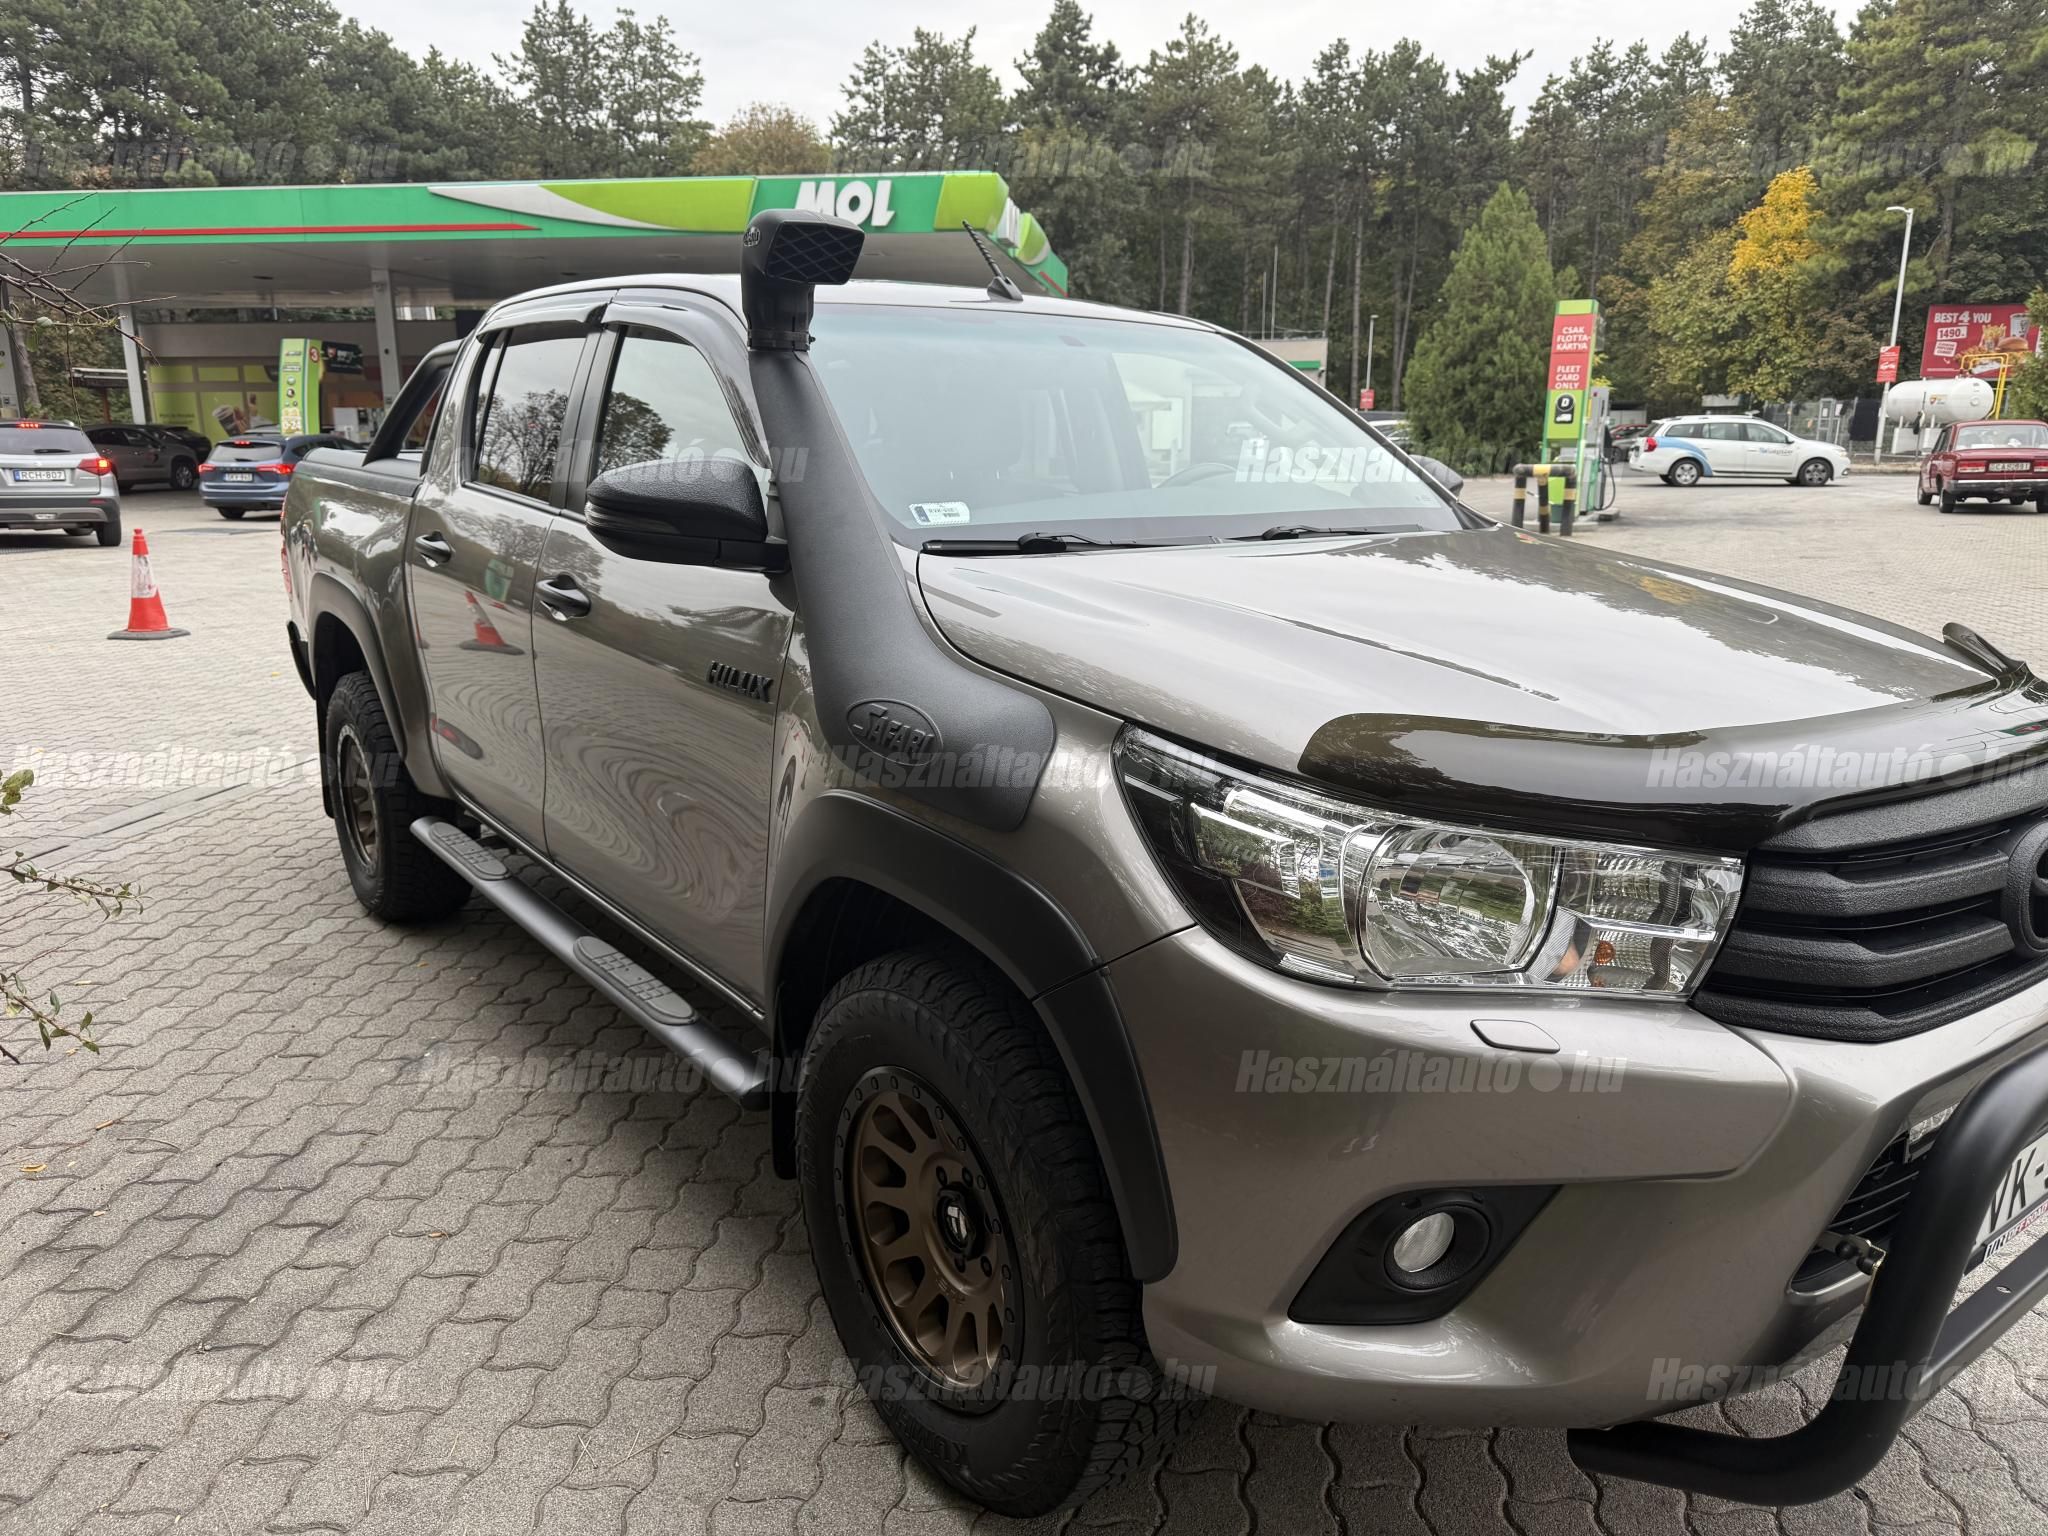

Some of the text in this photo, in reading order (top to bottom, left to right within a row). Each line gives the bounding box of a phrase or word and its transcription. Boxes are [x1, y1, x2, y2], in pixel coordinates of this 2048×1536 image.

[793, 180, 894, 227] MOL
[1933, 310, 1992, 323] BEST 4 YOU
[1562, 326, 1585, 334] CSAK
[1556, 365, 1581, 373] FLEET
[1555, 373, 1580, 381] CARD
[1561, 398, 1569, 407] D
[21, 471, 62, 479] RCH-807
[706, 660, 776, 704] HILUX
[853, 702, 935, 754] SAFARI
